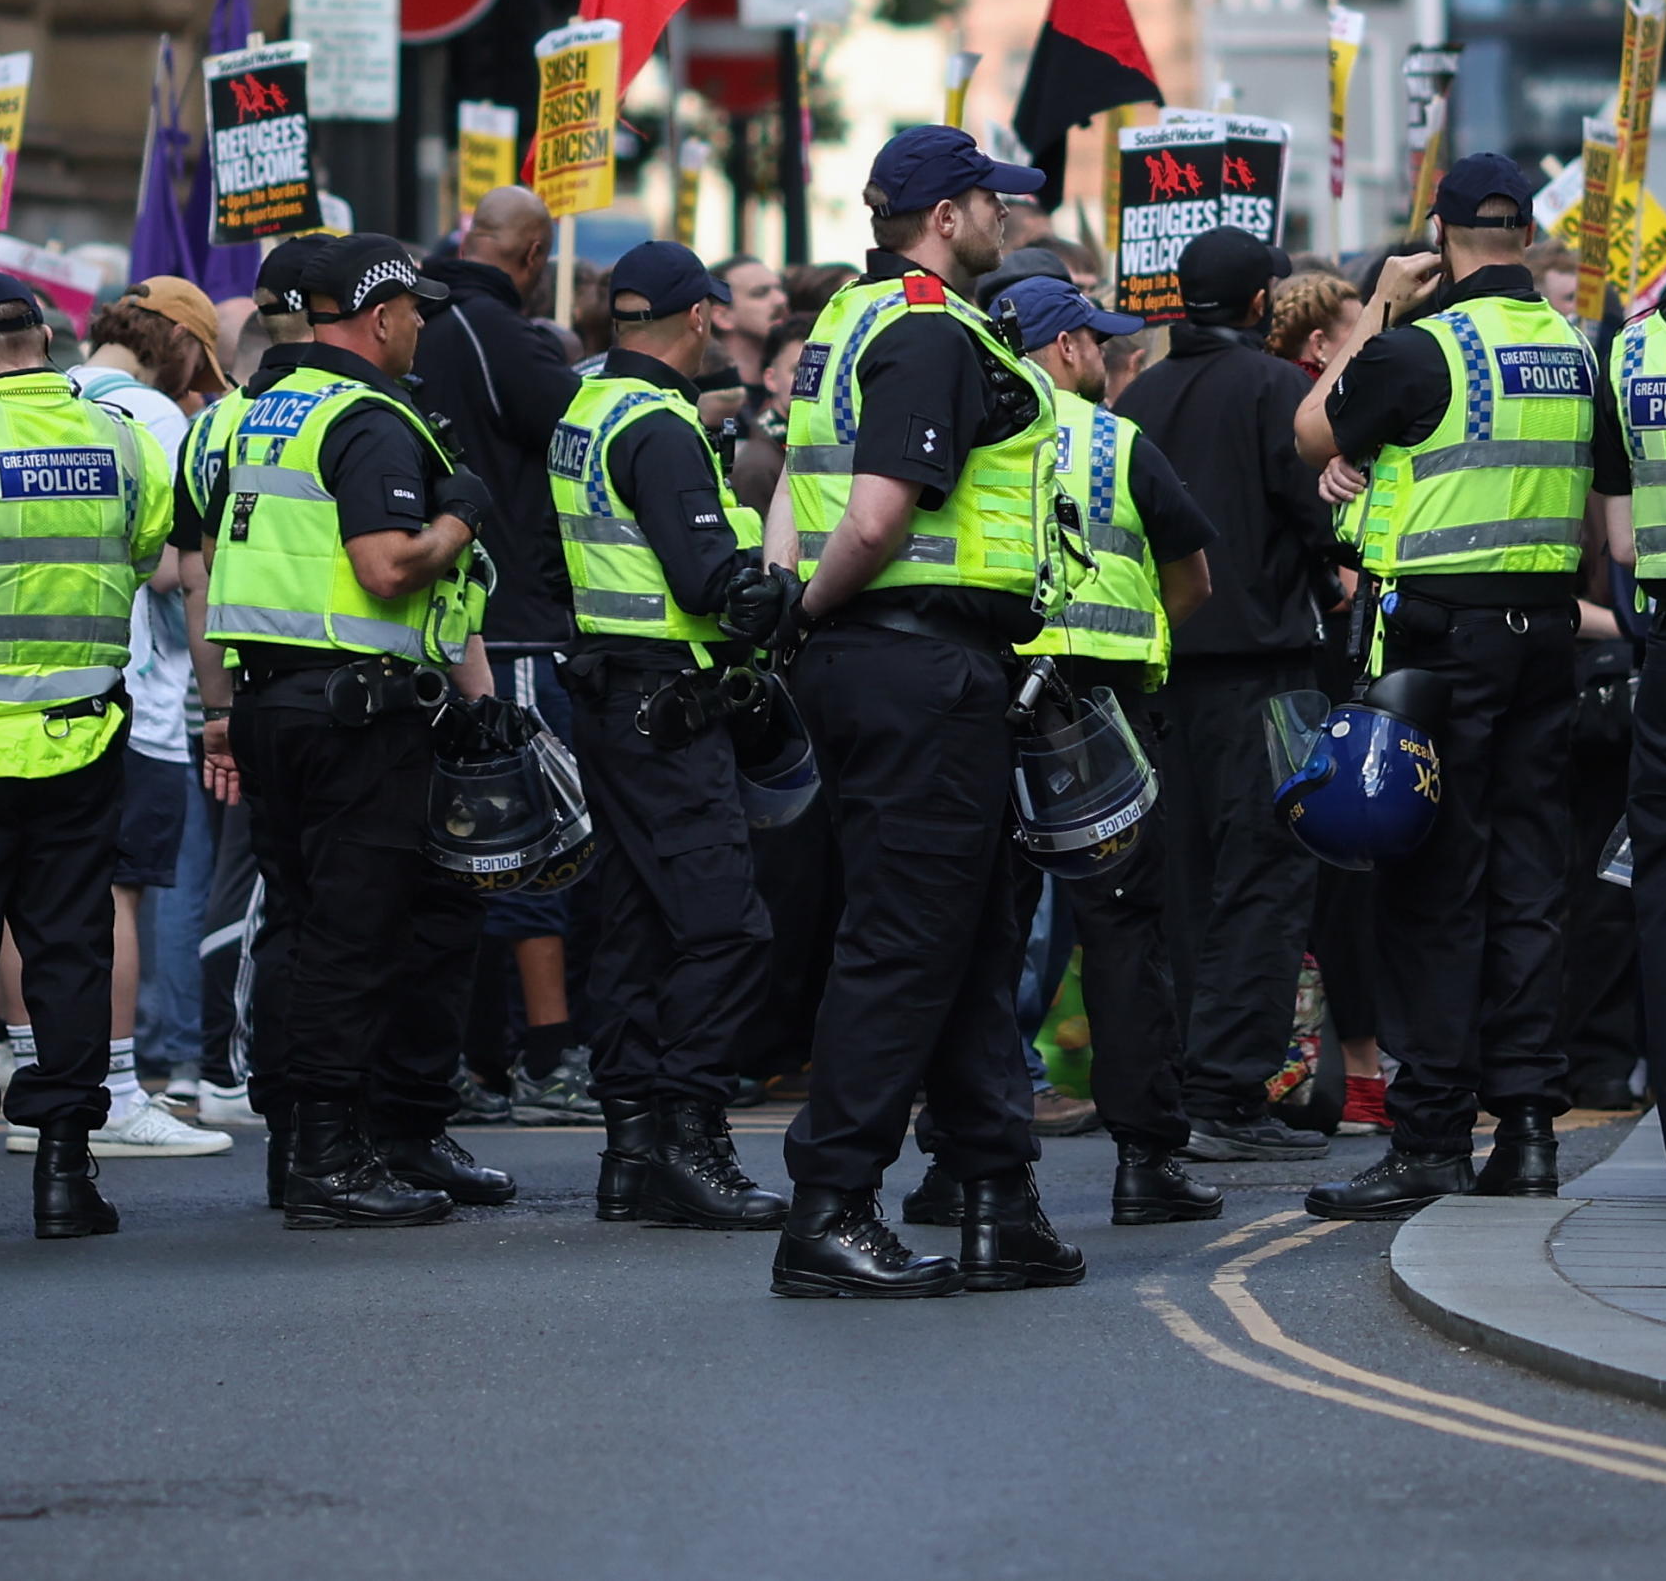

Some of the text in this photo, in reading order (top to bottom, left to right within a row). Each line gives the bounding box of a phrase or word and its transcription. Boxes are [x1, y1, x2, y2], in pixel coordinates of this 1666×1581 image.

[544, 50, 589, 91] SMASH
[216, 113, 308, 163] REFUGEES
[552, 130, 609, 168] RACISM
[217, 146, 309, 195] WELCOME
[1122, 198, 1219, 241] REFUGEES
[1122, 236, 1191, 276] WELCO
[1500, 350, 1584, 366] GREATER MANCHESTER
[1519, 366, 1581, 390] POLICE
[249, 396, 314, 429] POLICE
[2, 451, 114, 469] GREATER MANCHESTER
[548, 427, 589, 471] POLICE
[22, 468, 103, 493] POLICE
[1413, 762, 1442, 803] CK
[1098, 803, 1140, 839] POLICE
[474, 854, 521, 872] POLICE
